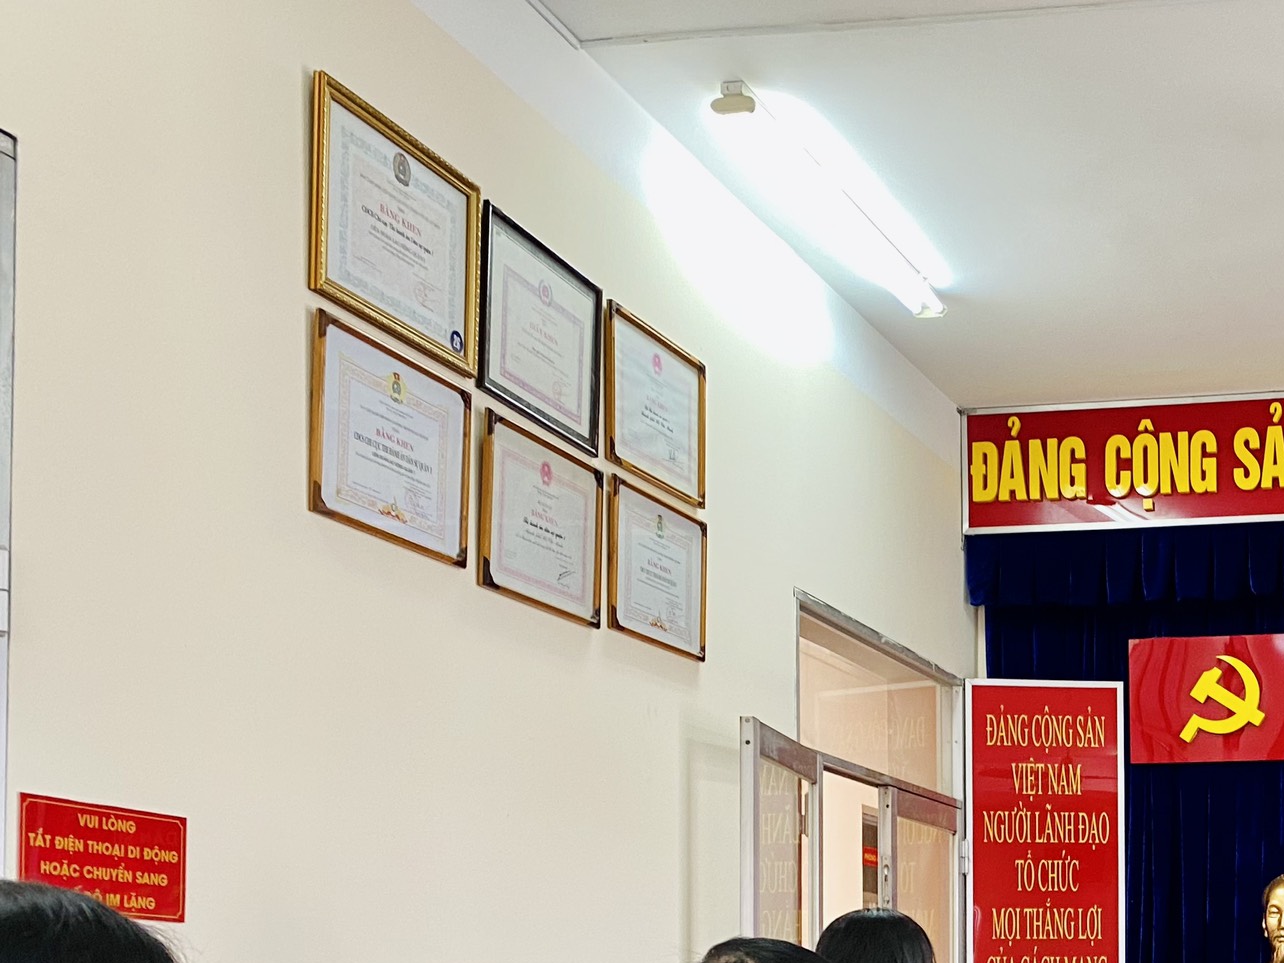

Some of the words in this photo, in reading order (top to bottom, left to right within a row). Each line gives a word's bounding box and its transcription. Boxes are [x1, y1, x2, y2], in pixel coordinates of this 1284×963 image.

[971, 415, 1087, 502] ĐẢNG
[1105, 419, 1218, 511] CỘNG
[986, 705, 1029, 747] ĐẢNG
[1031, 706, 1073, 754] CỘNG
[1076, 706, 1106, 748] SẢN
[1011, 757, 1045, 801] VIỆT
[1048, 763, 1082, 796] NAM
[77, 813, 99, 828] VUI
[102, 814, 136, 834] LÒNG
[983, 801, 1031, 844] NGƯỜI
[1034, 804, 1075, 844] LÃNH
[1078, 811, 1110, 851] ĐẠO
[28, 827, 52, 848] TẮT
[55, 834, 84, 855] ĐIỆN
[87, 840, 125, 861] THOẠI
[128, 846, 140, 859] DI
[143, 846, 179, 866] ĐỘNG
[40, 859, 80, 880] HOẶC
[83, 863, 133, 883] CHUYỂN
[135, 871, 168, 887] SANG
[1015, 849, 1035, 892] TỔ
[1037, 850, 1080, 892] CHỨC
[105, 893, 120, 907] IM
[123, 892, 156, 912] LẶNG
[991, 907, 1021, 947] MỌI
[1024, 899, 1075, 941] THẮNG
[1077, 905, 1102, 947] LỢI
